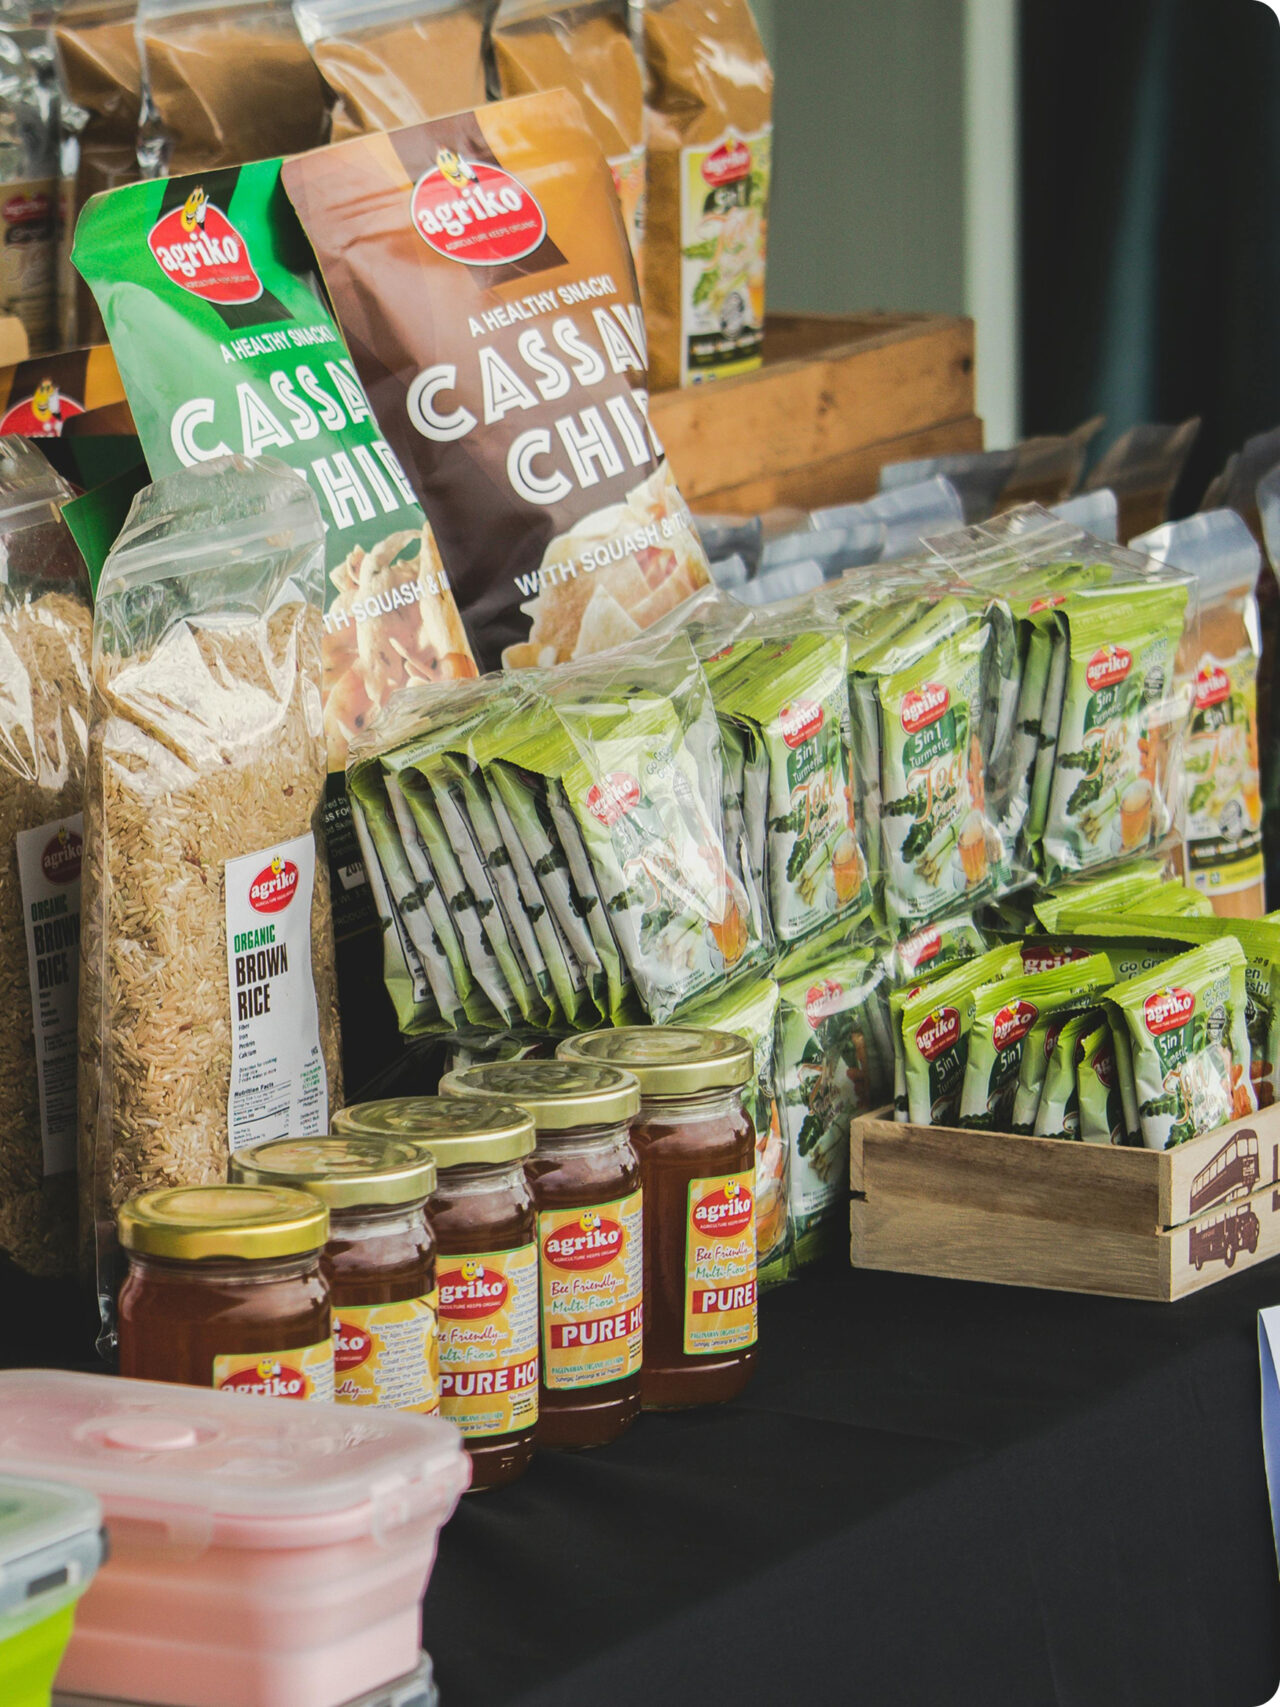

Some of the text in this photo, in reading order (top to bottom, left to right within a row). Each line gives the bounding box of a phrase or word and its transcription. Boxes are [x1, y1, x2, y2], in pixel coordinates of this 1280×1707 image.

[418, 185, 523, 237] agriko
[156, 230, 241, 277] agriko
[468, 273, 618, 338] A HEALTHY SNACK!
[220, 324, 337, 363] A HEALTHY SNACK!
[406, 303, 649, 441] CASSAV
[170, 359, 375, 468] CASSA
[293, 440, 419, 530] HIP
[515, 555, 578, 597] WITH
[581, 525, 660, 573] SQUASH
[660, 518, 674, 539] &
[321, 609, 350, 636] TH
[349, 581, 425, 624] SQUASH
[426, 574, 440, 596] &
[1088, 655, 1130, 681] agriko
[901, 686, 948, 723] agriko
[783, 707, 820, 738] agriko
[909, 738, 951, 769] Turmeric
[43, 843, 83, 871] agriko
[251, 871, 296, 900] agriko
[31, 893, 68, 922] ORGANIC
[234, 923, 276, 954] ORGANIC
[37, 952, 70, 991] RICE
[235, 942, 289, 988] BROWN
[1119, 957, 1166, 974] Go Gre
[237, 983, 271, 1021] RICE
[1146, 996, 1192, 1024] agriko
[917, 1015, 956, 1050] agriko
[696, 1198, 751, 1223] agriko
[547, 1228, 620, 1257] agriko
[696, 1247, 713, 1262] Bee
[439, 1280, 504, 1304] griko
[551, 1280, 569, 1296] Bee
[702, 1282, 754, 1314] PURE
[438, 1333, 447, 1343] ee
[562, 1316, 626, 1347] PURE
[439, 1346, 496, 1363] ulti-Fiora
[440, 1357, 539, 1397] PURE HO
